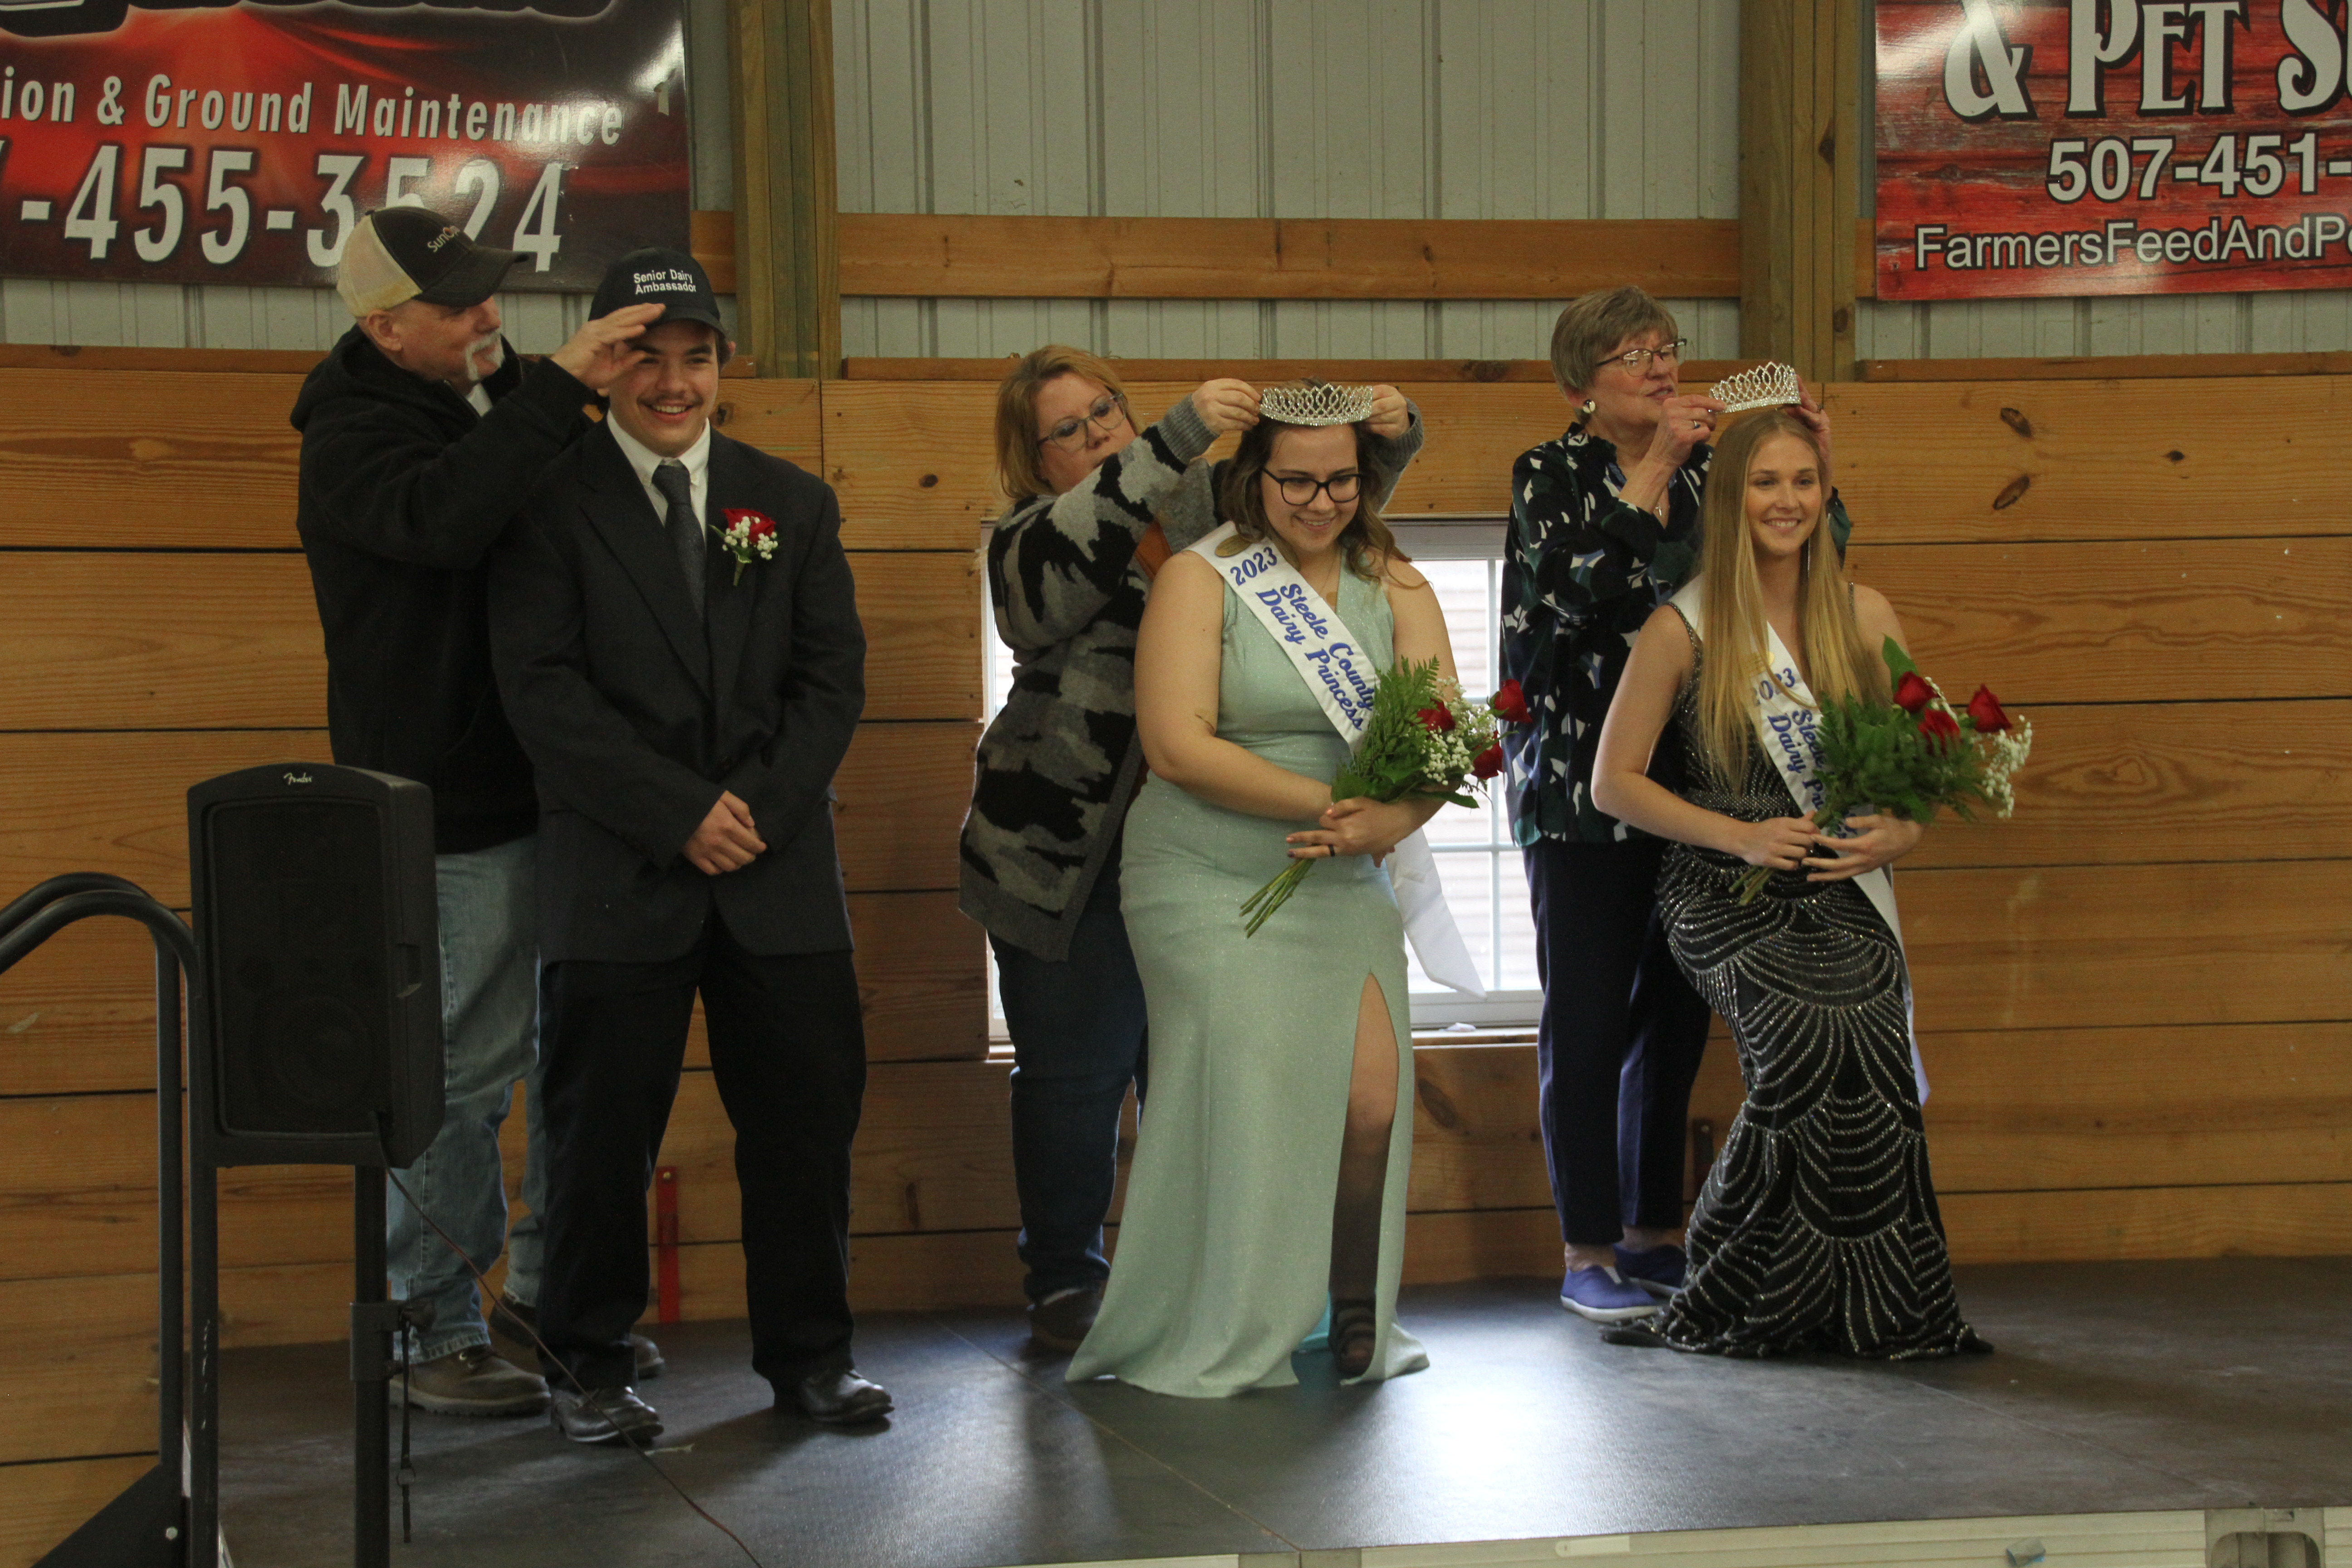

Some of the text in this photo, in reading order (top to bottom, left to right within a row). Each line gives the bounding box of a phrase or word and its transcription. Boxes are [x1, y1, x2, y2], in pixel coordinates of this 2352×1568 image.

[1945, 0, 2352, 118] & PET S
[97, 76, 125, 126] &
[145, 74, 312, 134] Ground
[334, 83, 623, 145] Maintenance
[1916, 216, 2352, 268] FarmersFeedAndP
[633, 268, 693, 284] Senior Dairy
[635, 281, 696, 295] Ambassador
[1230, 546, 1278, 586] 2023
[1255, 588, 1363, 731] Dairy Princess
[1280, 583, 1374, 711] Steele County
[1767, 713, 1806, 774] Dairy
[283, 772, 314, 785] Fender
